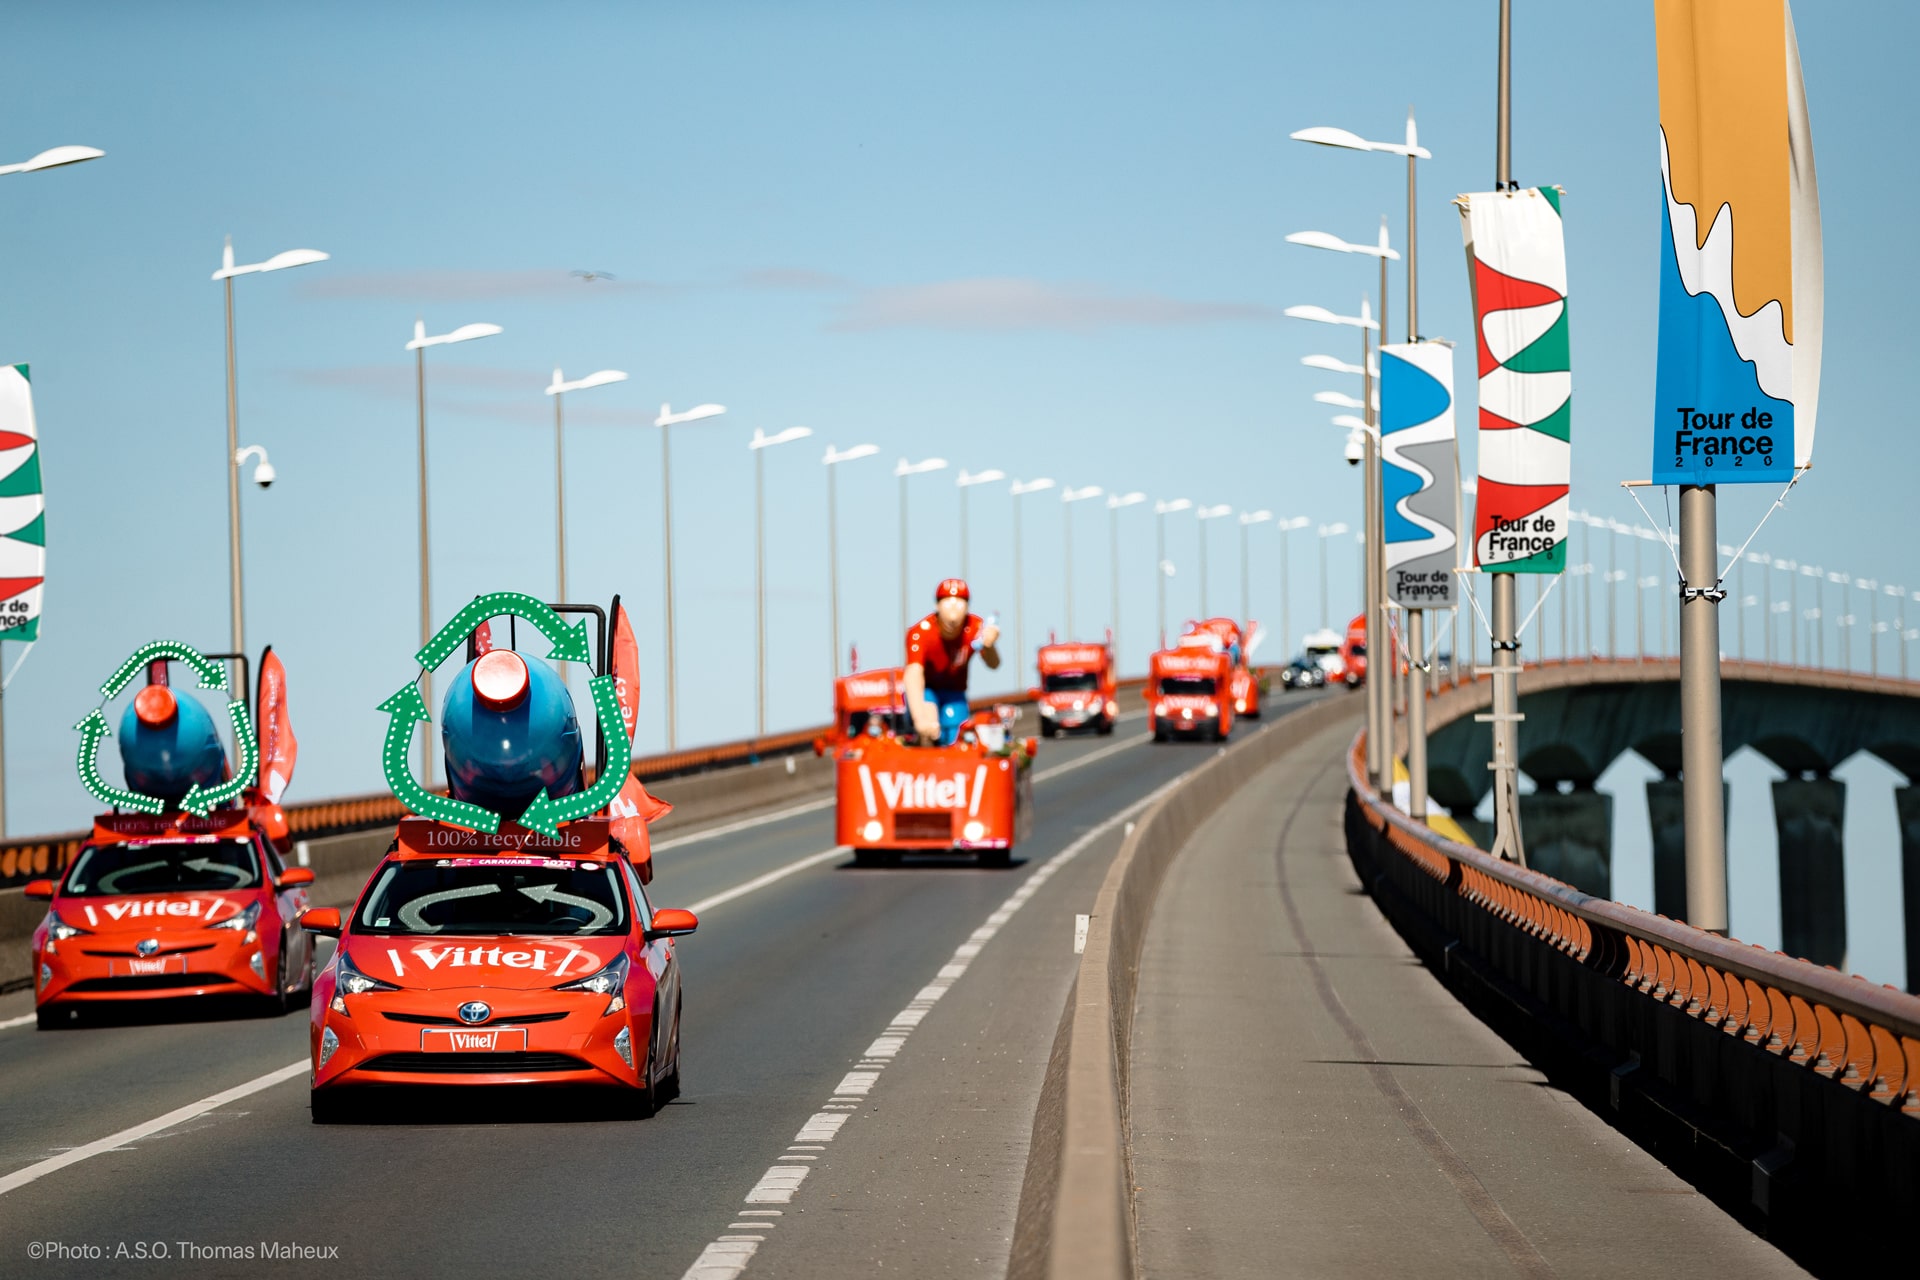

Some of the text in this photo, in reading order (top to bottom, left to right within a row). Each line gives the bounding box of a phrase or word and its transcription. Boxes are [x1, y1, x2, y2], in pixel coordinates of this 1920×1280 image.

[1677, 406, 1773, 430] Tour de
[1675, 430, 1773, 455] France
[1490, 514, 1555, 532] Tour de
[1489, 532, 1554, 551] France
[1396, 570, 1449, 582] Tour de
[1396, 582, 1449, 595] France
[9, 599, 29, 613] de
[0, 615, 27, 626] nce
[875, 772, 967, 810] Vittel
[427, 831, 582, 850] 100% recyclable
[104, 900, 200, 920] Vittel
[134, 960, 161, 972] Vittel
[413, 946, 547, 971] Vittel
[455, 1033, 494, 1049] Vittel
